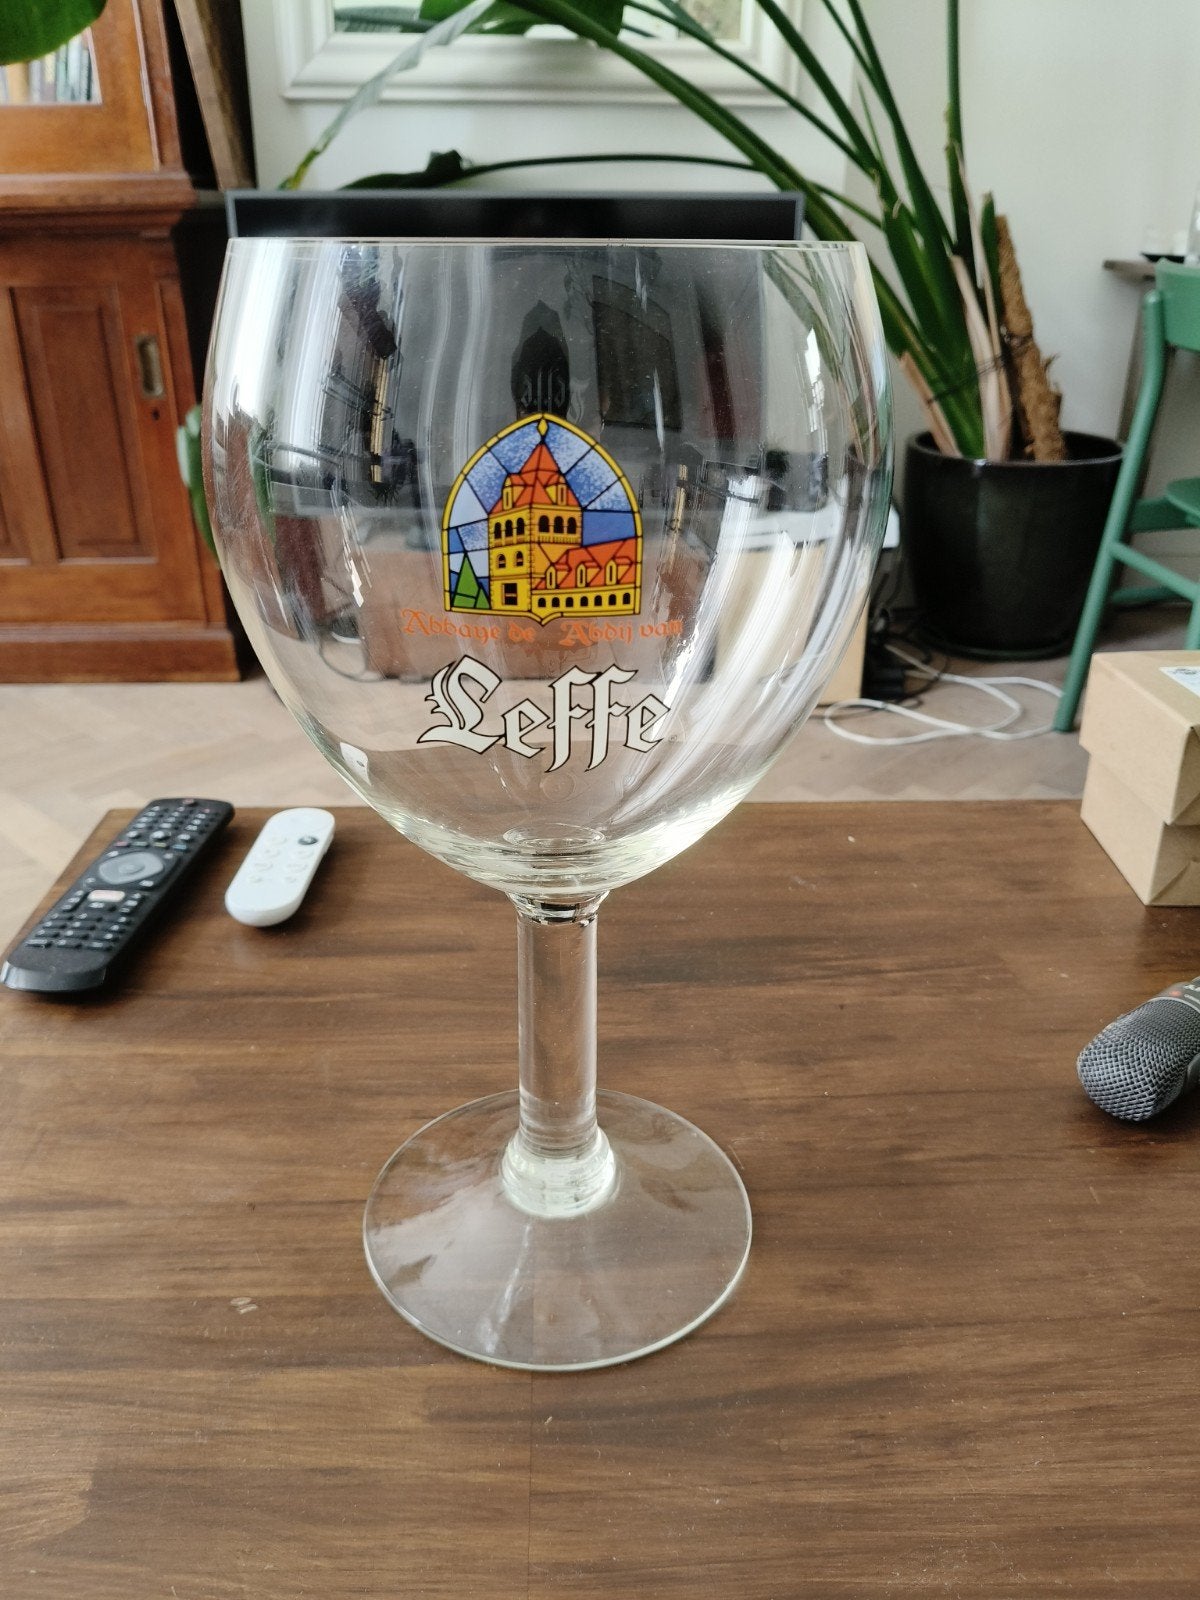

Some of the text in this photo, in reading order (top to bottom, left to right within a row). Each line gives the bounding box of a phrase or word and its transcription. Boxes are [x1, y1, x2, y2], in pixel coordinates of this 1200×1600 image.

[402, 608, 683, 646] Abbaye de Abdij van
[416, 655, 671, 772] Leffe
